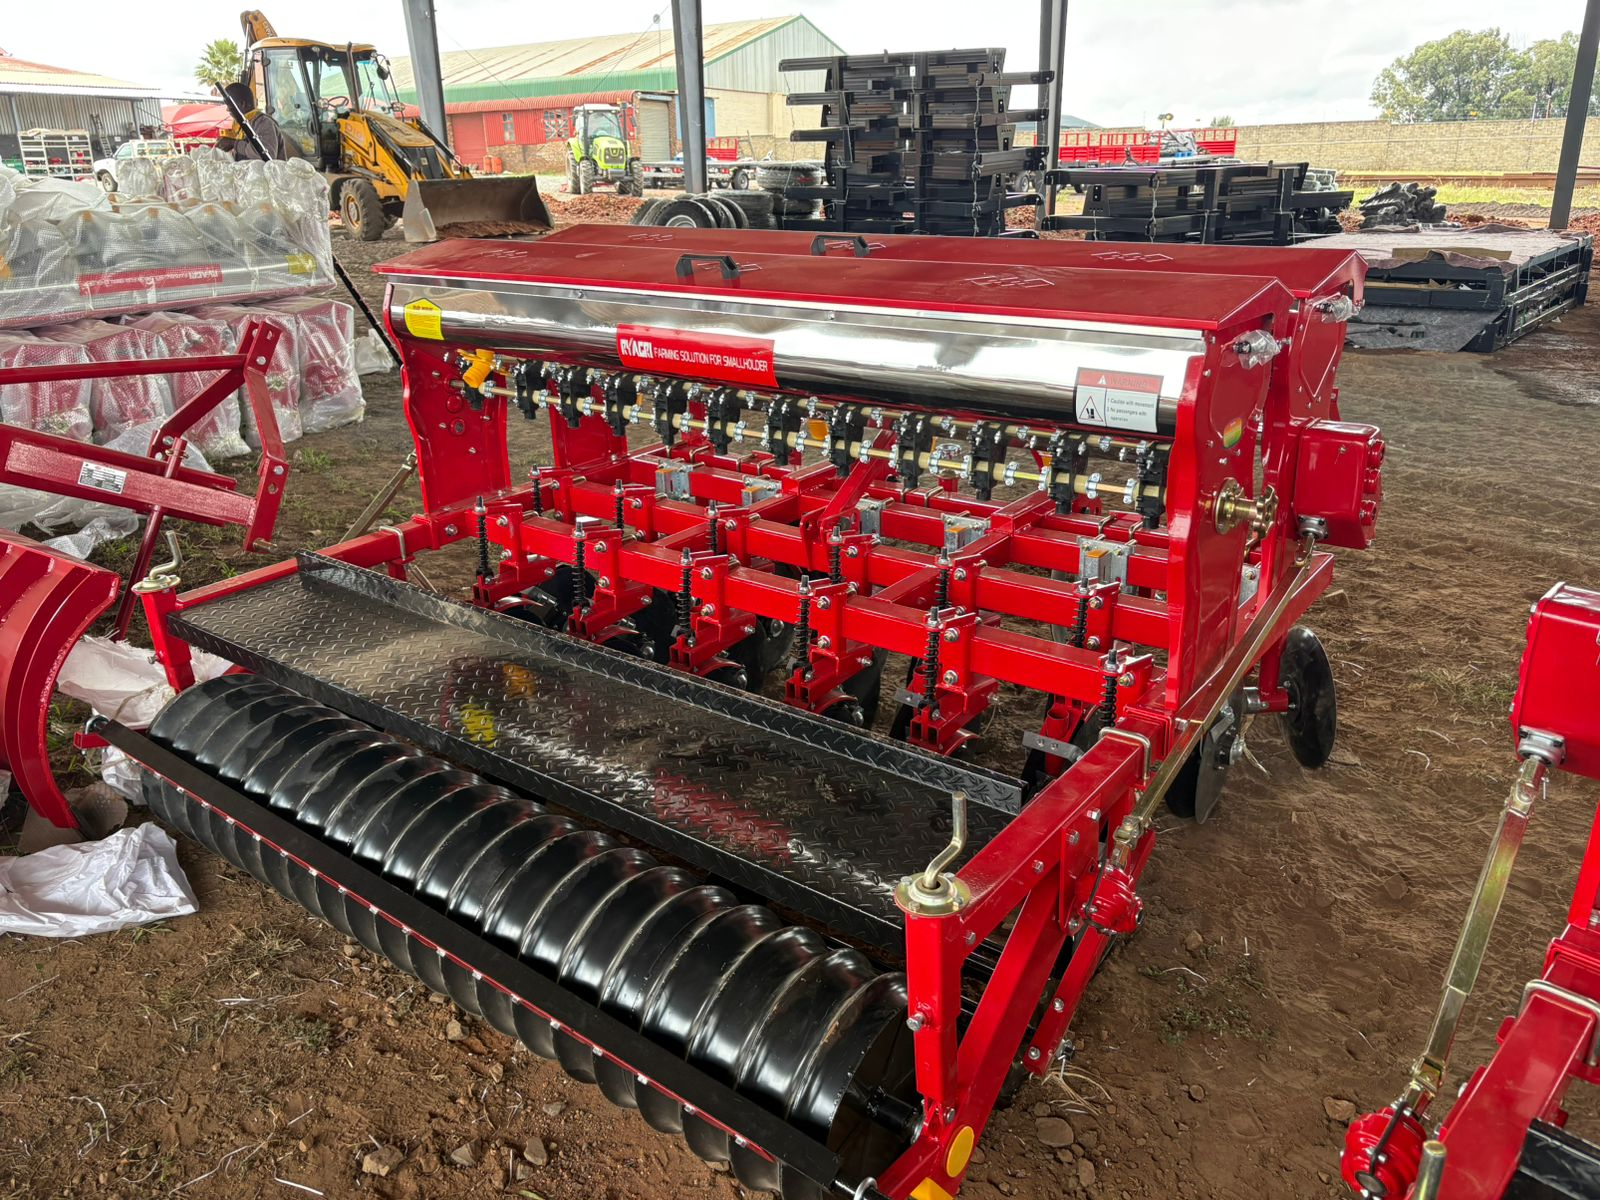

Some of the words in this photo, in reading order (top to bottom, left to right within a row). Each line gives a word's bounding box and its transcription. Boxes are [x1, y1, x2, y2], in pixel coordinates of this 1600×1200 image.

[620, 338, 653, 359] RYAGRI
[653, 347, 680, 361] FARMING
[680, 350, 709, 365] SOLUTION
[709, 354, 722, 366] FOR
[723, 355, 768, 372] SMALLHOLDER
